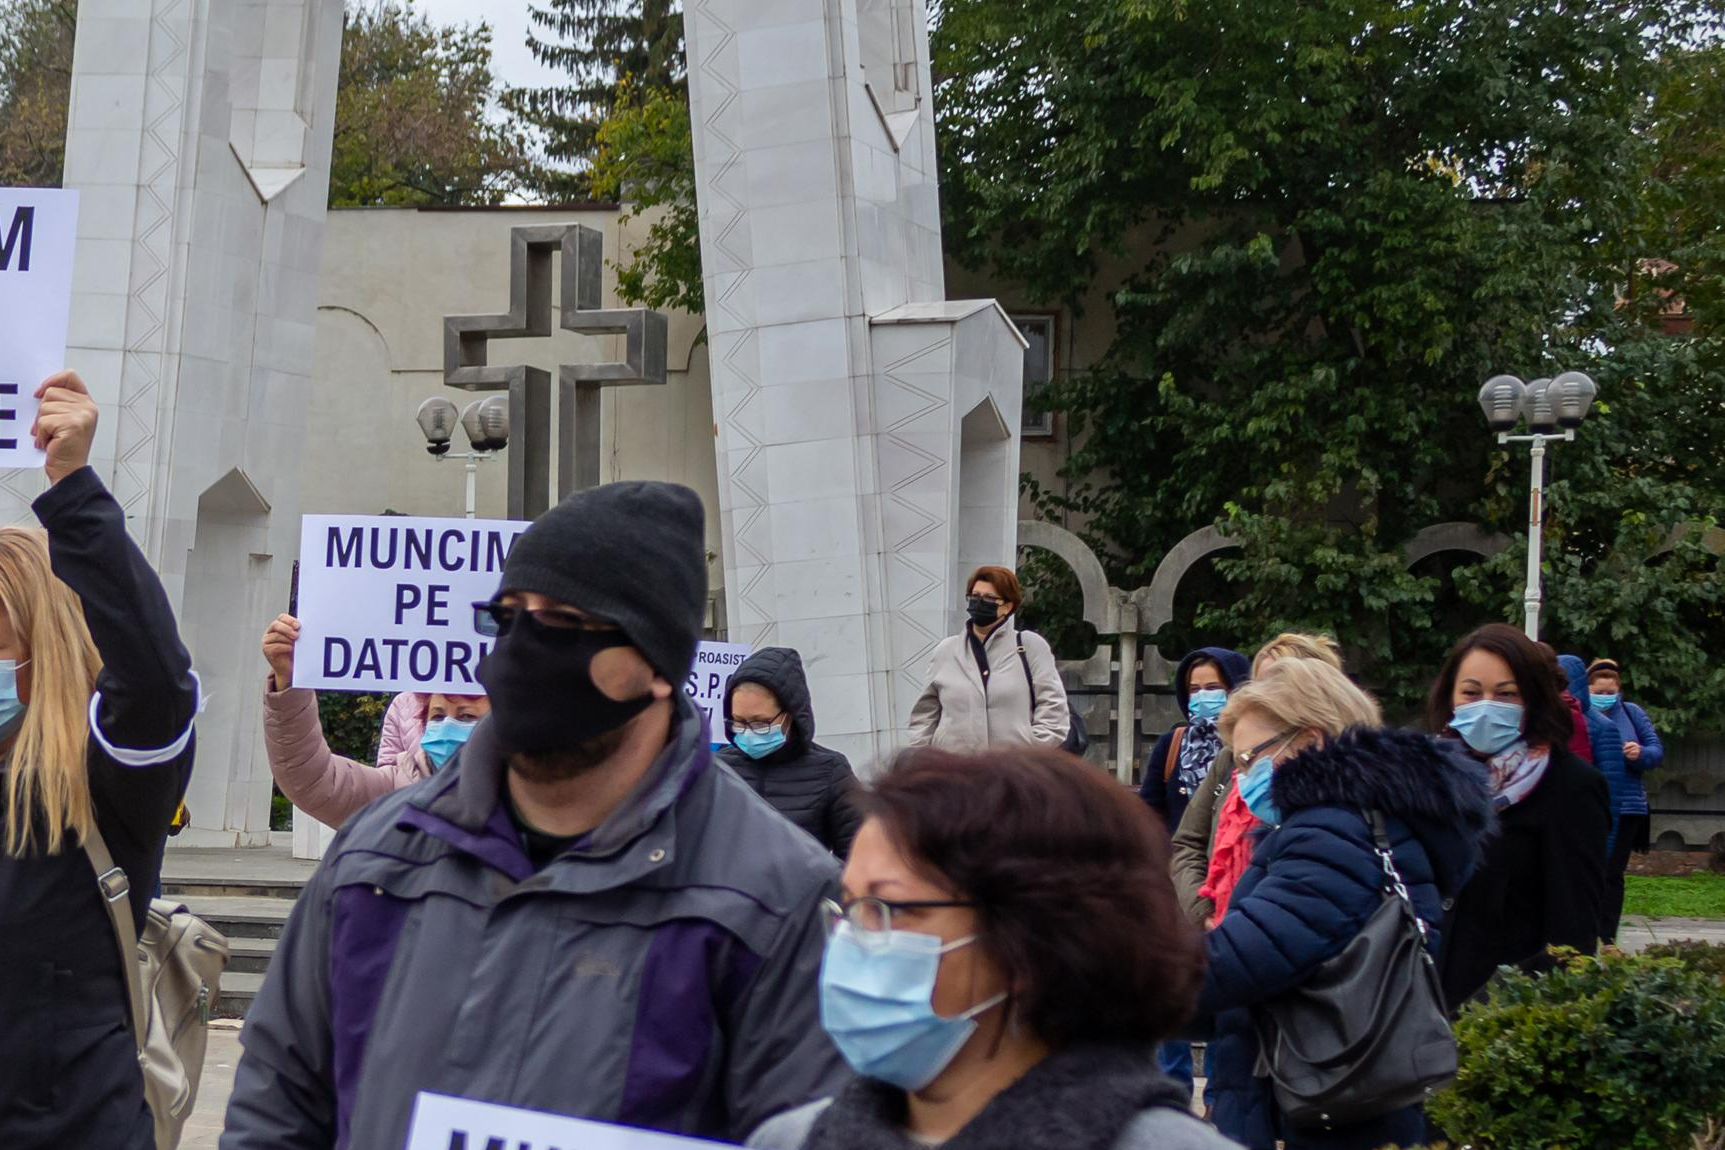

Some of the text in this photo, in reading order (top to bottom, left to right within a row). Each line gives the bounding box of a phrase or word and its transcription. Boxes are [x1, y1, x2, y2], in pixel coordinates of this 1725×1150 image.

[394, 583, 451, 626] PE
[322, 636, 488, 684] DATOR
[695, 651, 747, 666] ROASIST
